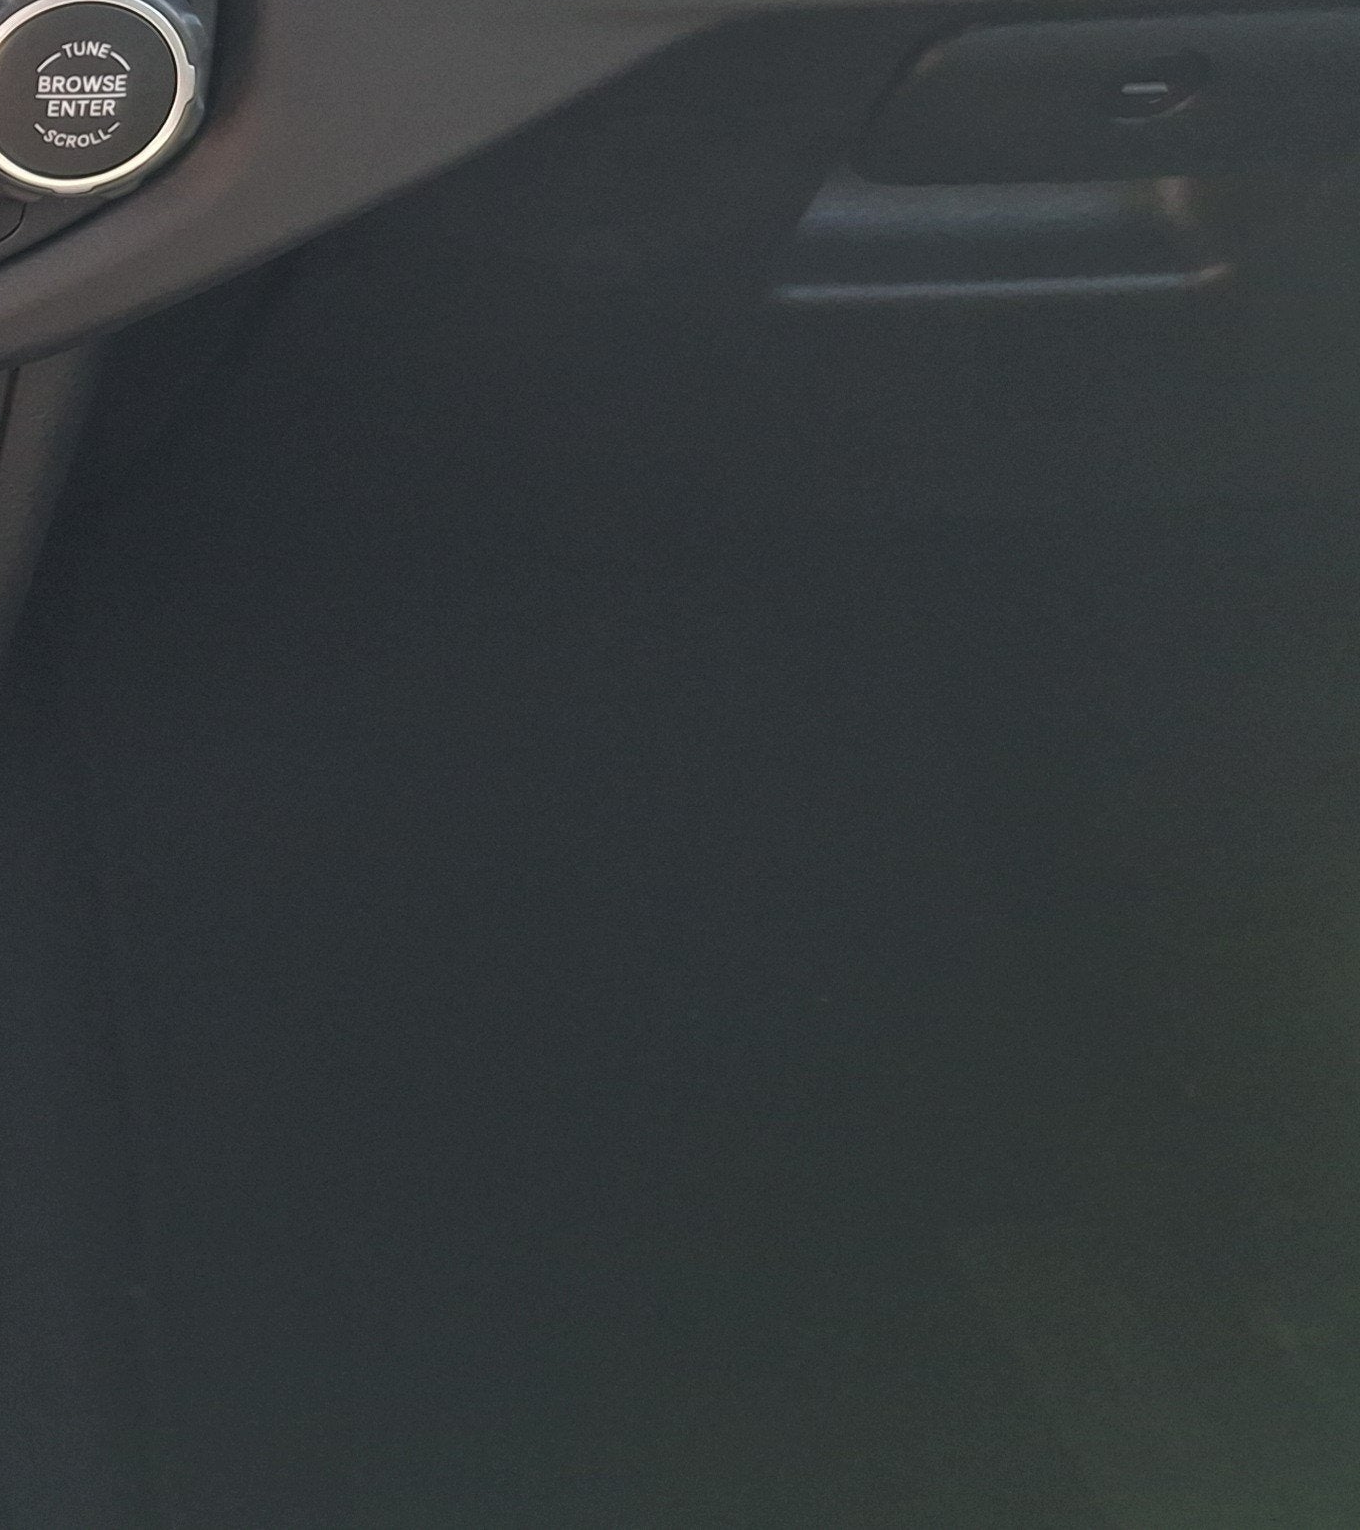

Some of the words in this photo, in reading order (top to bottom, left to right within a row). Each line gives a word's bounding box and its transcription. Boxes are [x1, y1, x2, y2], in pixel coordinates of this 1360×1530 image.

[62, 41, 112, 60] TUNE
[37, 73, 127, 95] BROWSE
[46, 98, 116, 118] ENTER
[43, 128, 111, 148] SCROLL
